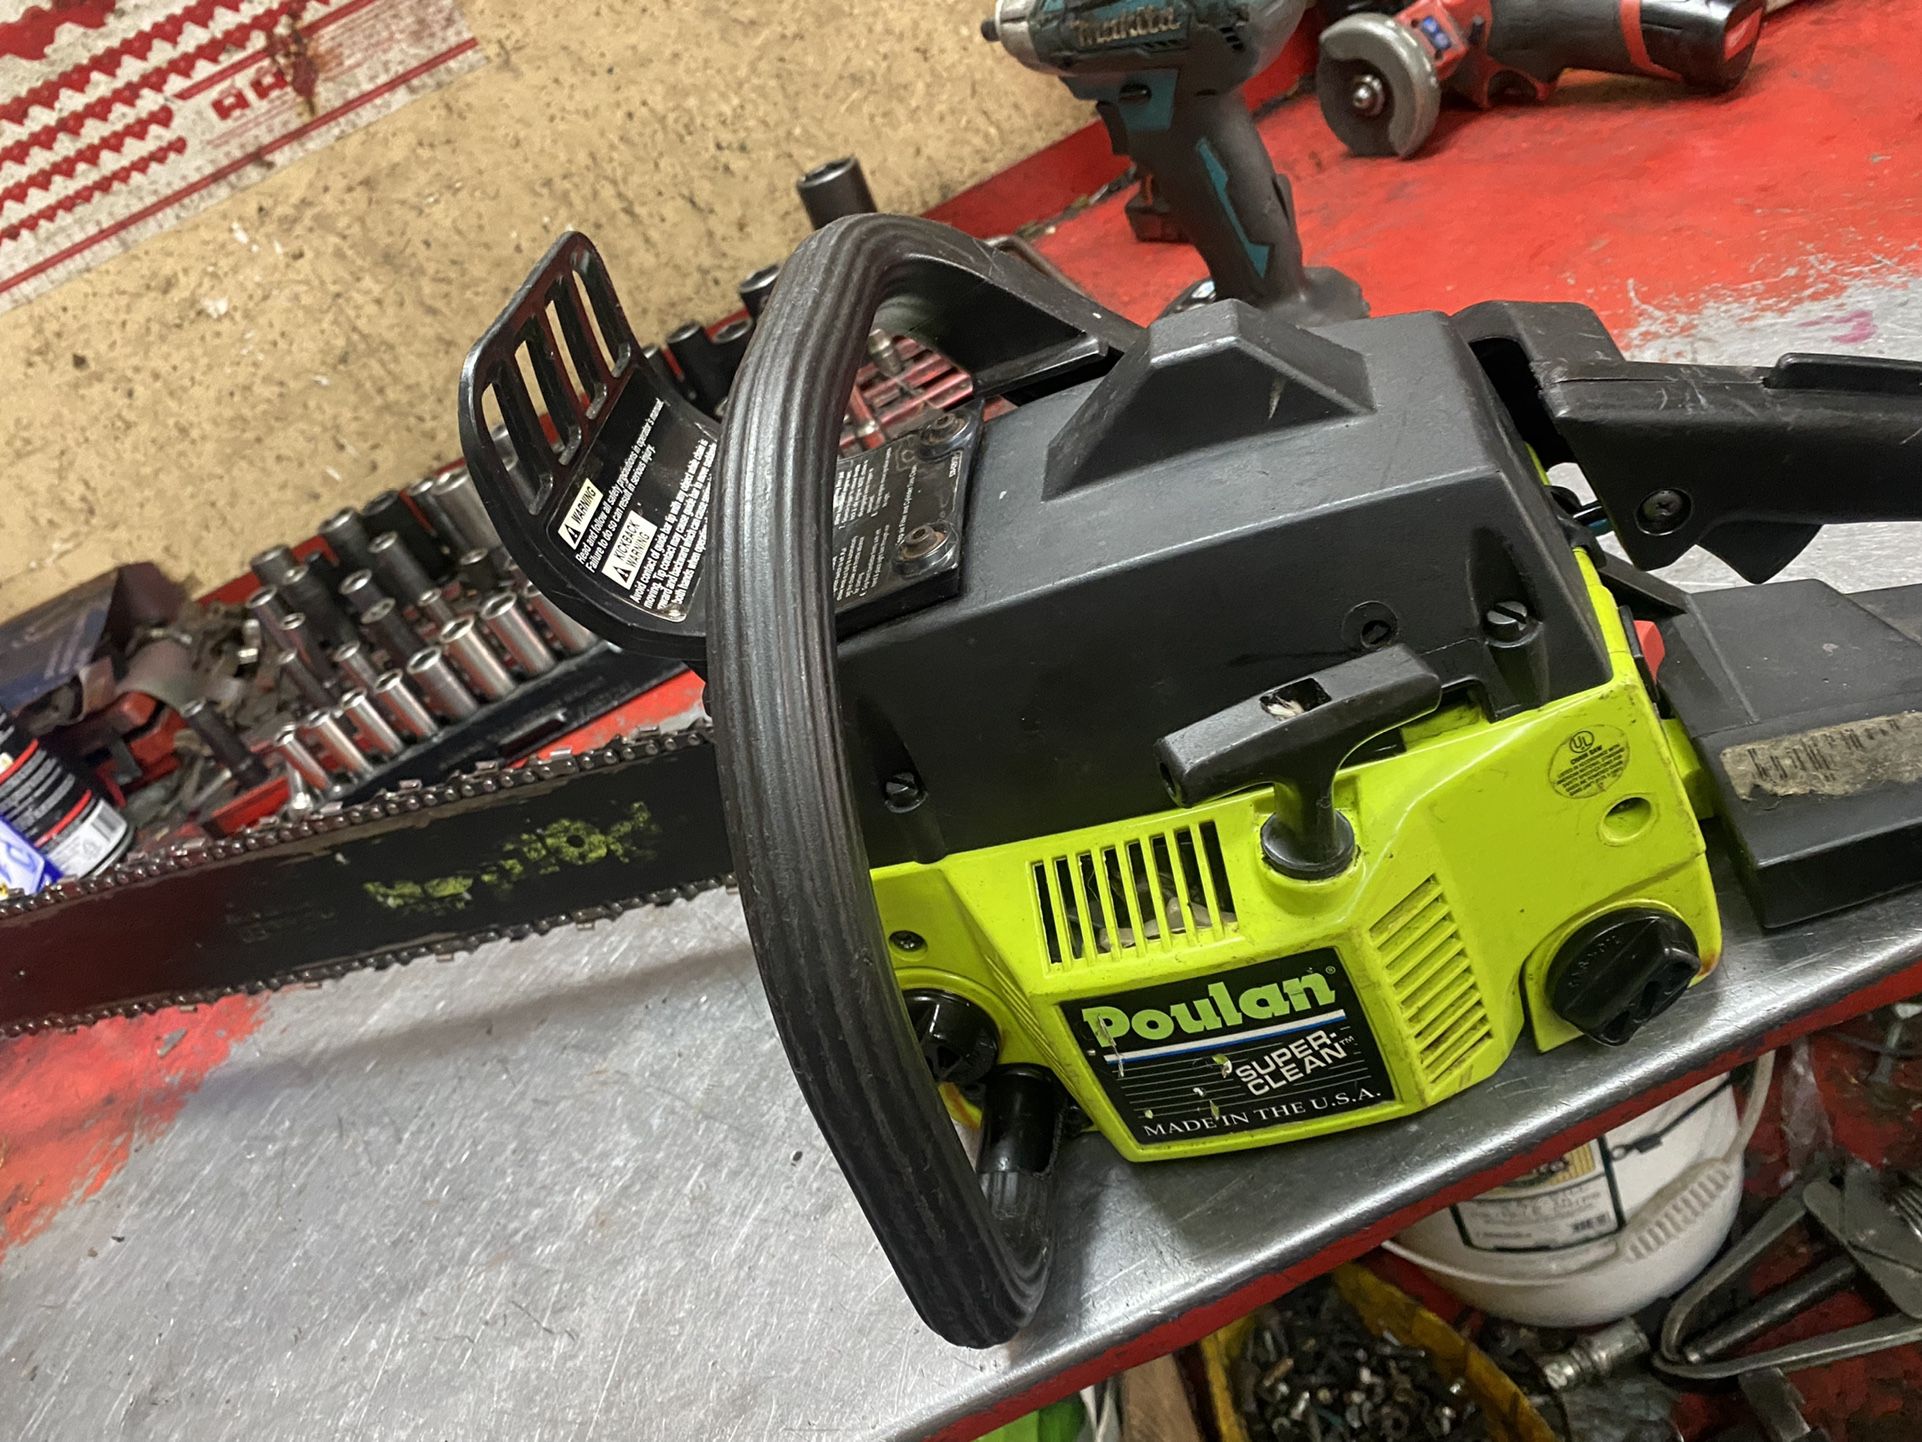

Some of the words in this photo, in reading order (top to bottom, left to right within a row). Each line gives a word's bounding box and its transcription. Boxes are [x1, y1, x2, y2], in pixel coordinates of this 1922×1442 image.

[698, 438, 708, 446] is
[641, 444, 655, 463] injury.
[693, 444, 706, 460] chain
[630, 460, 645, 484] serious
[687, 458, 699, 474] while
[574, 541, 591, 564] Read
[584, 528, 597, 547] and
[591, 510, 607, 533] follow
[602, 500, 612, 514] all
[607, 483, 622, 505] safety
[616, 451, 637, 488] precautions
[631, 444, 641, 454] in
[636, 417, 654, 447] operator's
[626, 482, 635, 492] in
[680, 472, 693, 491] object
[619, 488, 632, 510] result
[675, 489, 688, 502] any
[688, 487, 700, 499] bar
[570, 485, 597, 524] WARNING
[669, 499, 681, 514] with
[683, 497, 696, 515] guide
[694, 501, 707, 519] cause
[613, 506, 623, 522] can
[665, 512, 677, 523] tip
[676, 513, 689, 533] cause
[608, 520, 617, 531] so
[659, 522, 672, 534] bar
[690, 517, 700, 530] can
[598, 539, 607, 548] to
[603, 528, 612, 541] do
[613, 519, 639, 560] KICKBACK
[653, 531, 667, 552] guide
[671, 532, 684, 546] may
[625, 530, 650, 567] WARNING
[650, 548, 659, 559] of
[659, 544, 676, 570] contact
[586, 546, 604, 573] Failure
[669, 545, 689, 576] backward
[688, 550, 700, 569] when
[640, 556, 657, 583] contact
[652, 569, 666, 580] Tip
[679, 568, 693, 589] hands
[666, 573, 677, 589] and
[630, 580, 646, 603] Avoid
[643, 581, 662, 607] moving.
[673, 586, 686, 603] both
[1082, 973, 1336, 1047] Poulan
[1247, 1042, 1347, 1096] CLEAN
[1143, 1116, 1218, 1136] MADE
[1221, 1112, 1249, 1127] IN
[1253, 1101, 1306, 1120] THE
[1311, 1087, 1381, 1111] U.S.A.
